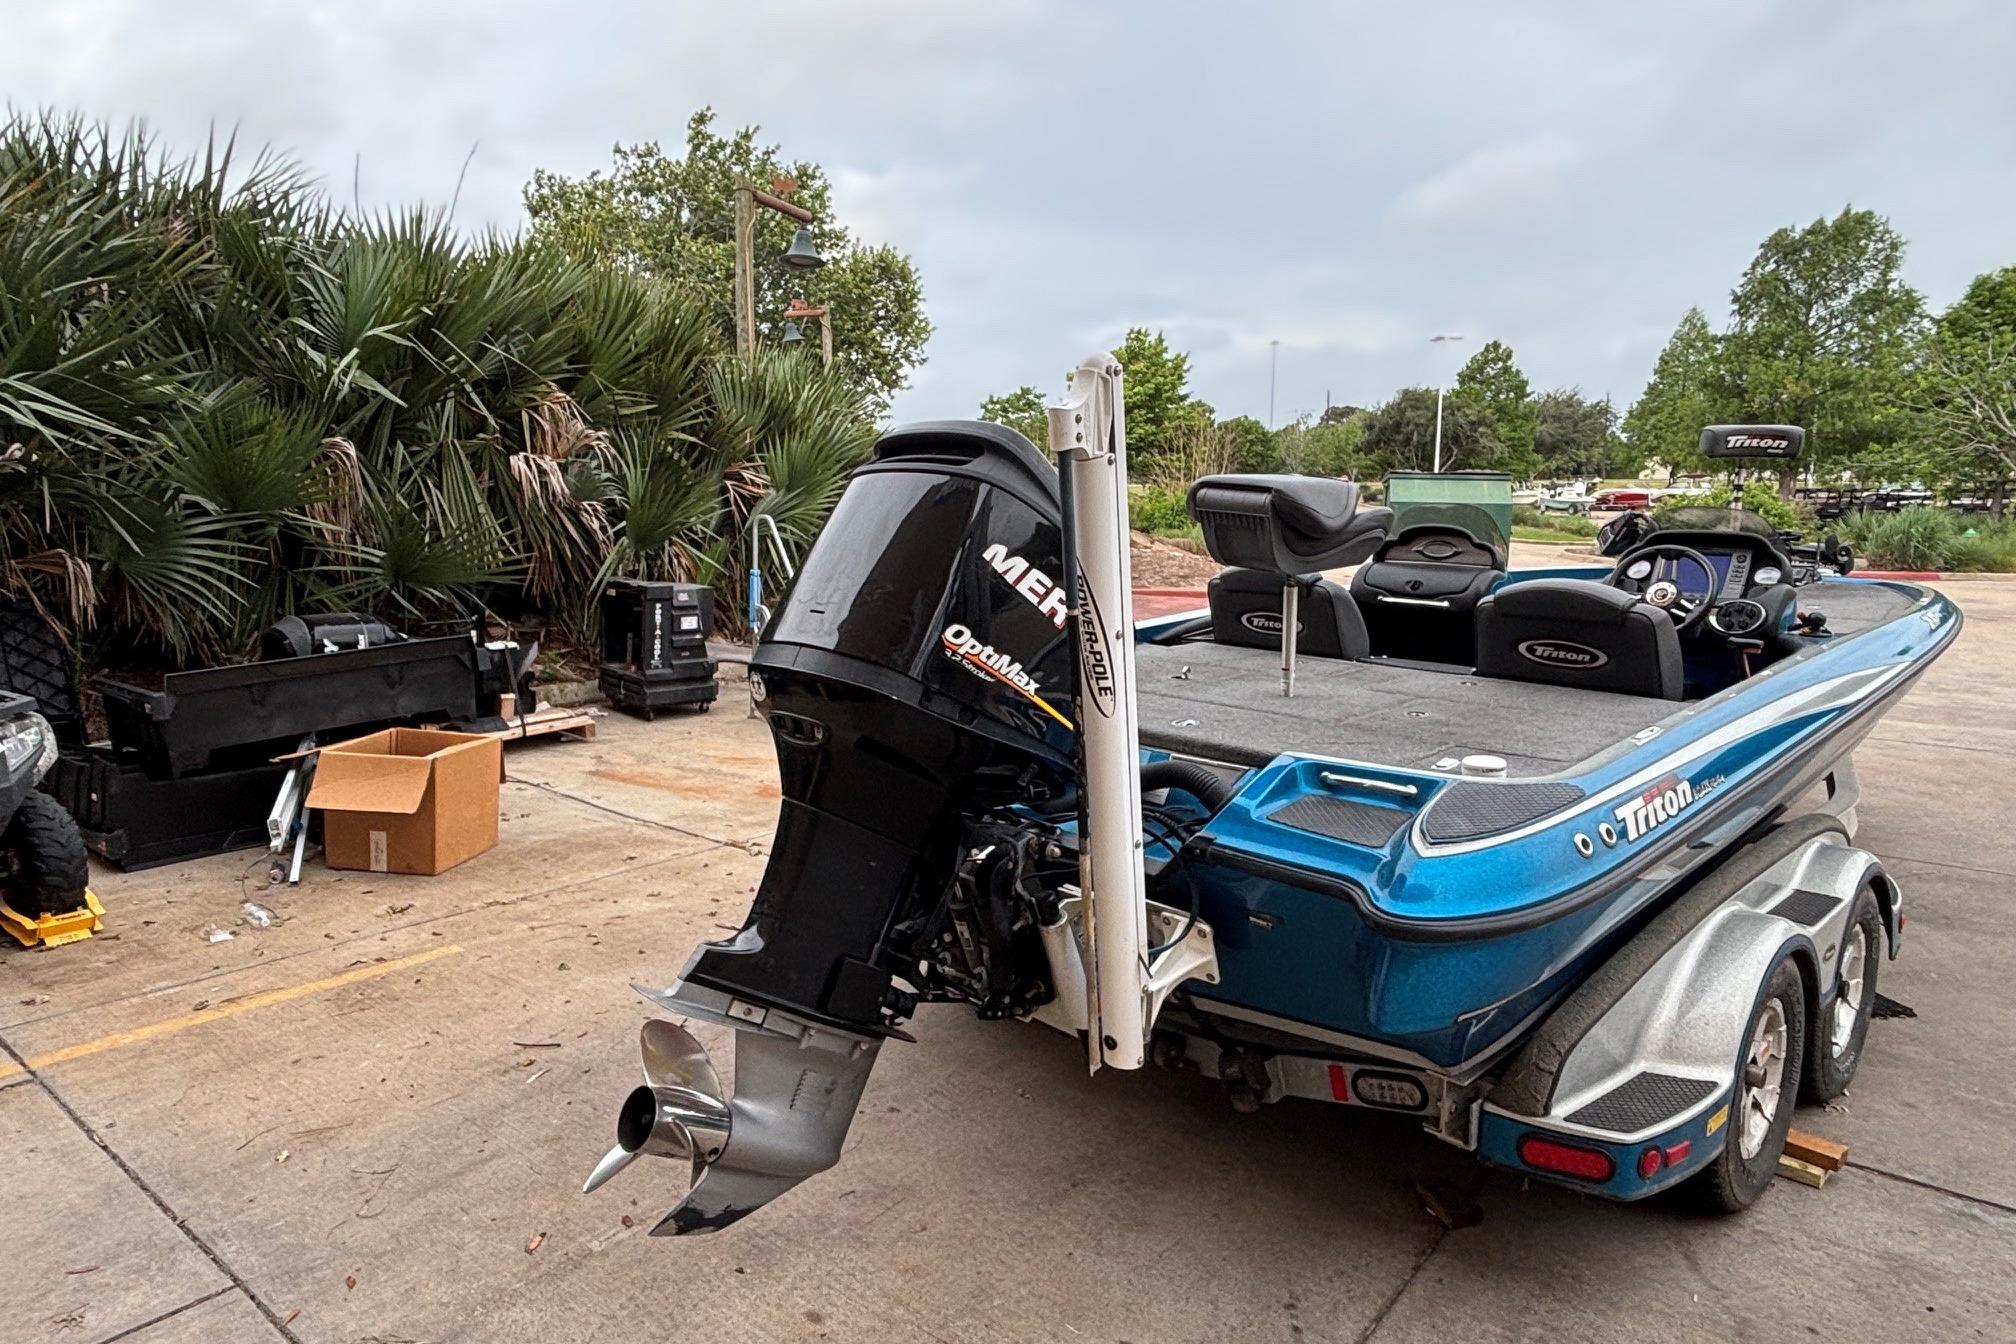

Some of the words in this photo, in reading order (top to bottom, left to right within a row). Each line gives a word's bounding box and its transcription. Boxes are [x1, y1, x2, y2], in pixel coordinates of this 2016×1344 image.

[1726, 435, 1789, 449] Triton
[982, 543, 1068, 628] MER
[1250, 617, 1283, 629] Trito
[943, 623, 1041, 696] OptiMax
[1532, 645, 1591, 662] Triton
[1614, 780, 1695, 843] Triton
